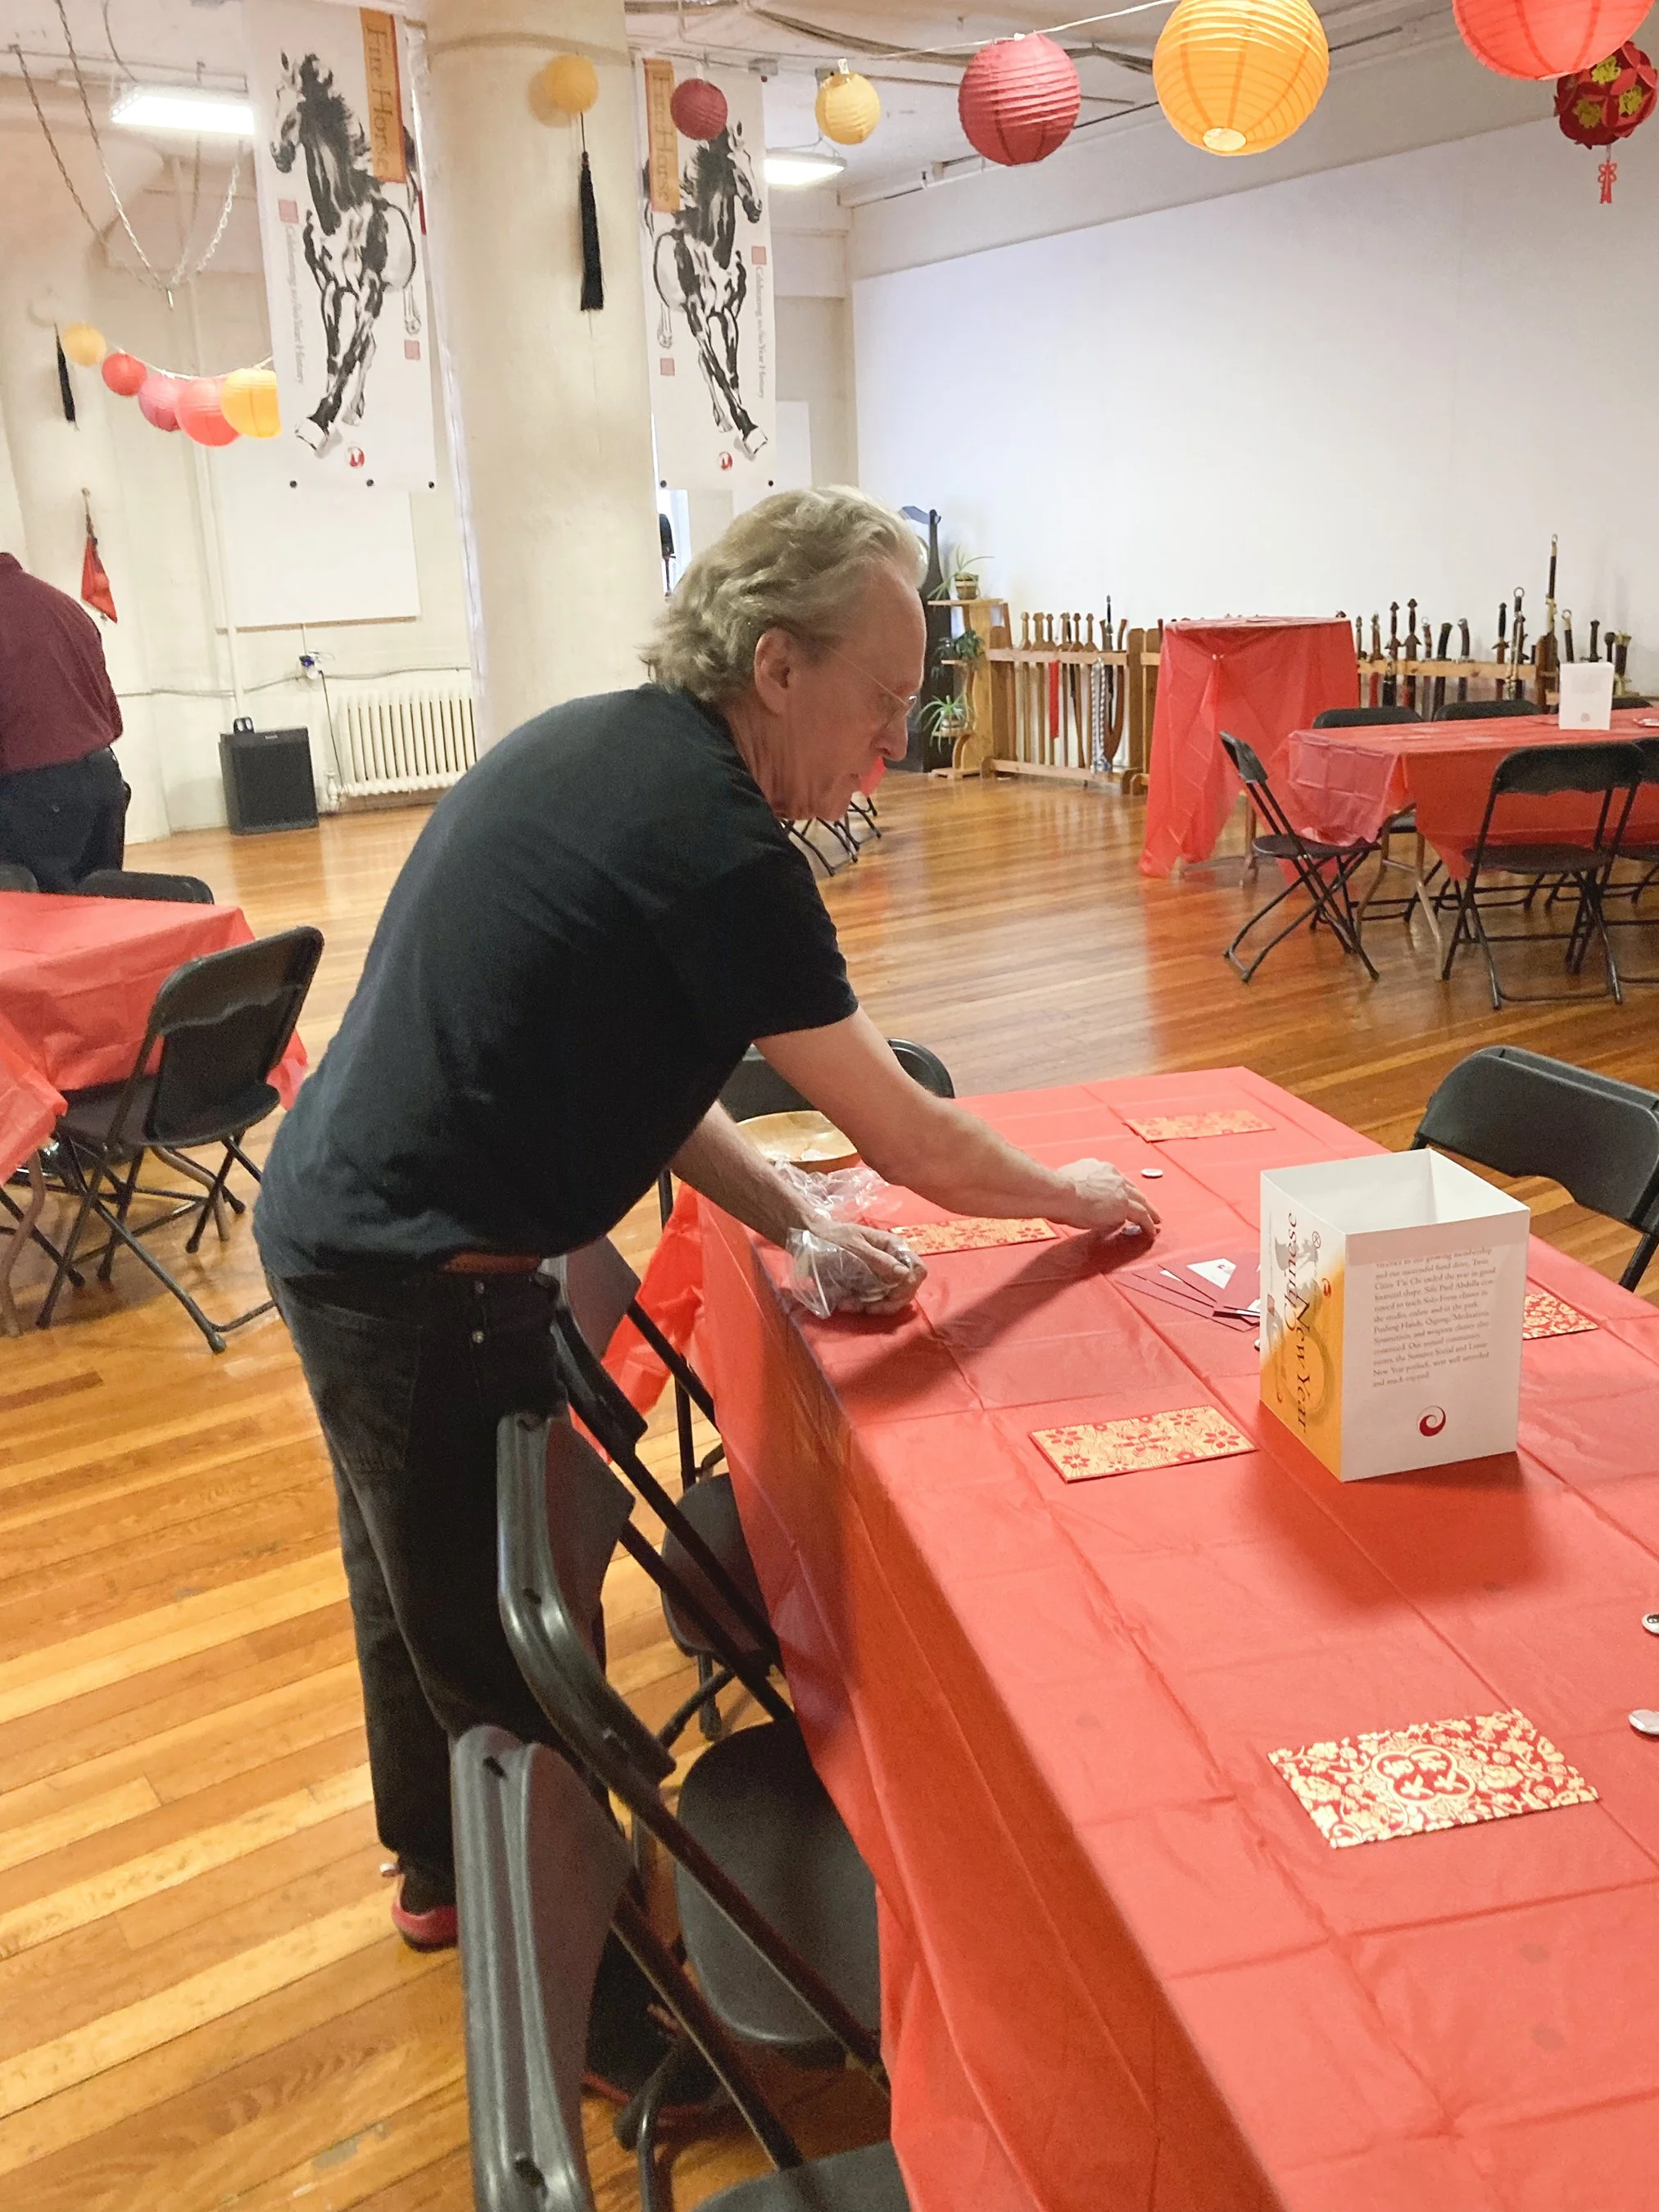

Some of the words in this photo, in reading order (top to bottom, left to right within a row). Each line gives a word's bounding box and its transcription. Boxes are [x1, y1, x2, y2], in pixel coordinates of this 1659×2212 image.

[372, 85, 393, 172] Horse
[655, 125, 675, 204] Horse
[1284, 1213, 1297, 1331] Chinese
[1409, 1276, 1421, 1285] Chi
[1444, 1272, 1455, 1281] the
[1479, 1266, 1495, 1276] good
[1296, 1294, 1311, 1369] New
[1297, 1374, 1311, 1433] Year
